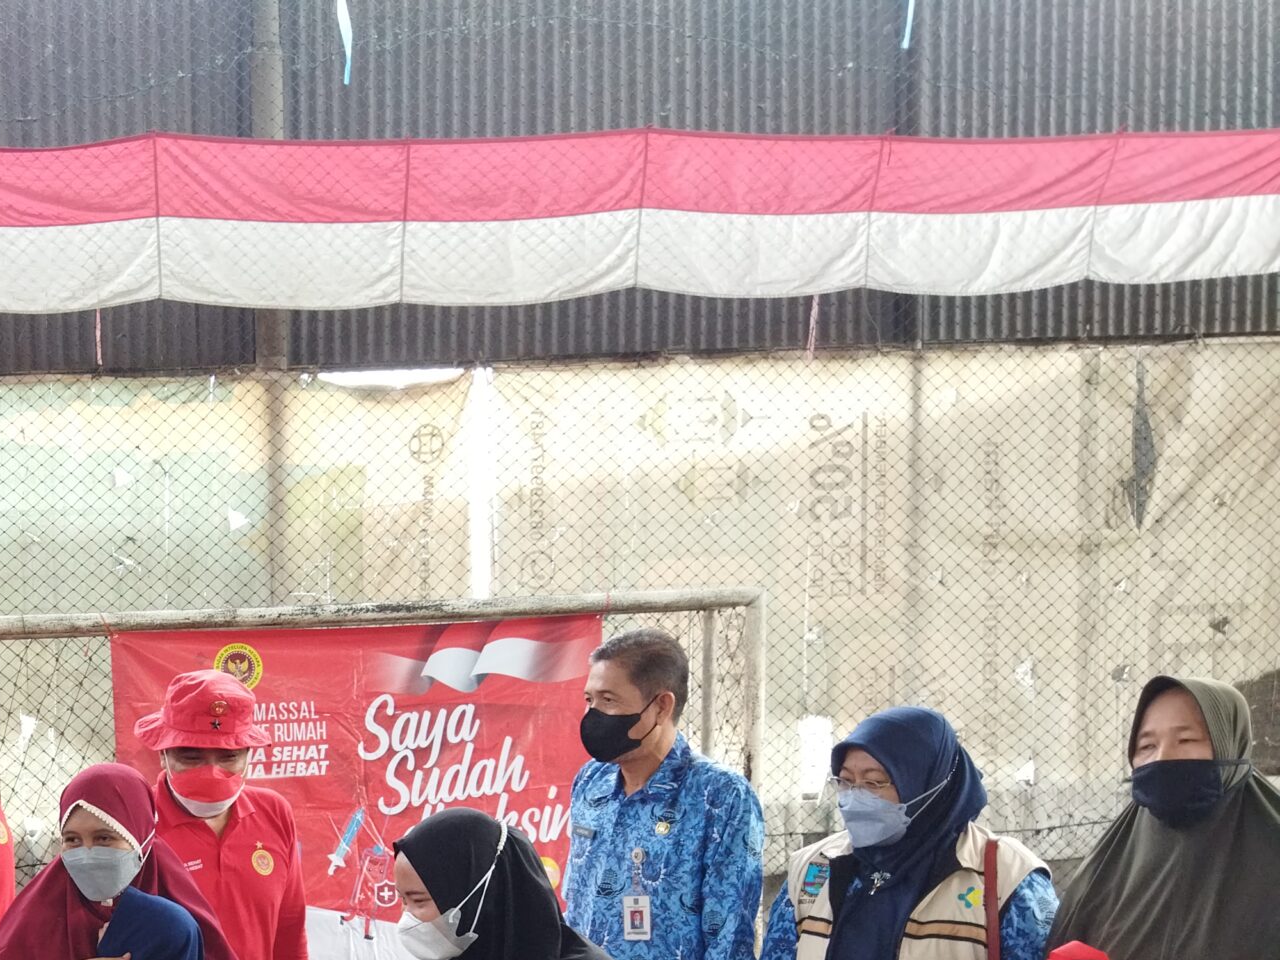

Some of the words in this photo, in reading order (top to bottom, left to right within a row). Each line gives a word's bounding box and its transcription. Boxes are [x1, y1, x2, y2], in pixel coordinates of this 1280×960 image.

[253, 701, 320, 721] MASSAL
[274, 721, 326, 742] RUMAH
[358, 694, 480, 768] Saya
[271, 744, 329, 762] SEHAT
[270, 761, 330, 778] HEBAT
[378, 736, 530, 815] Sudah
